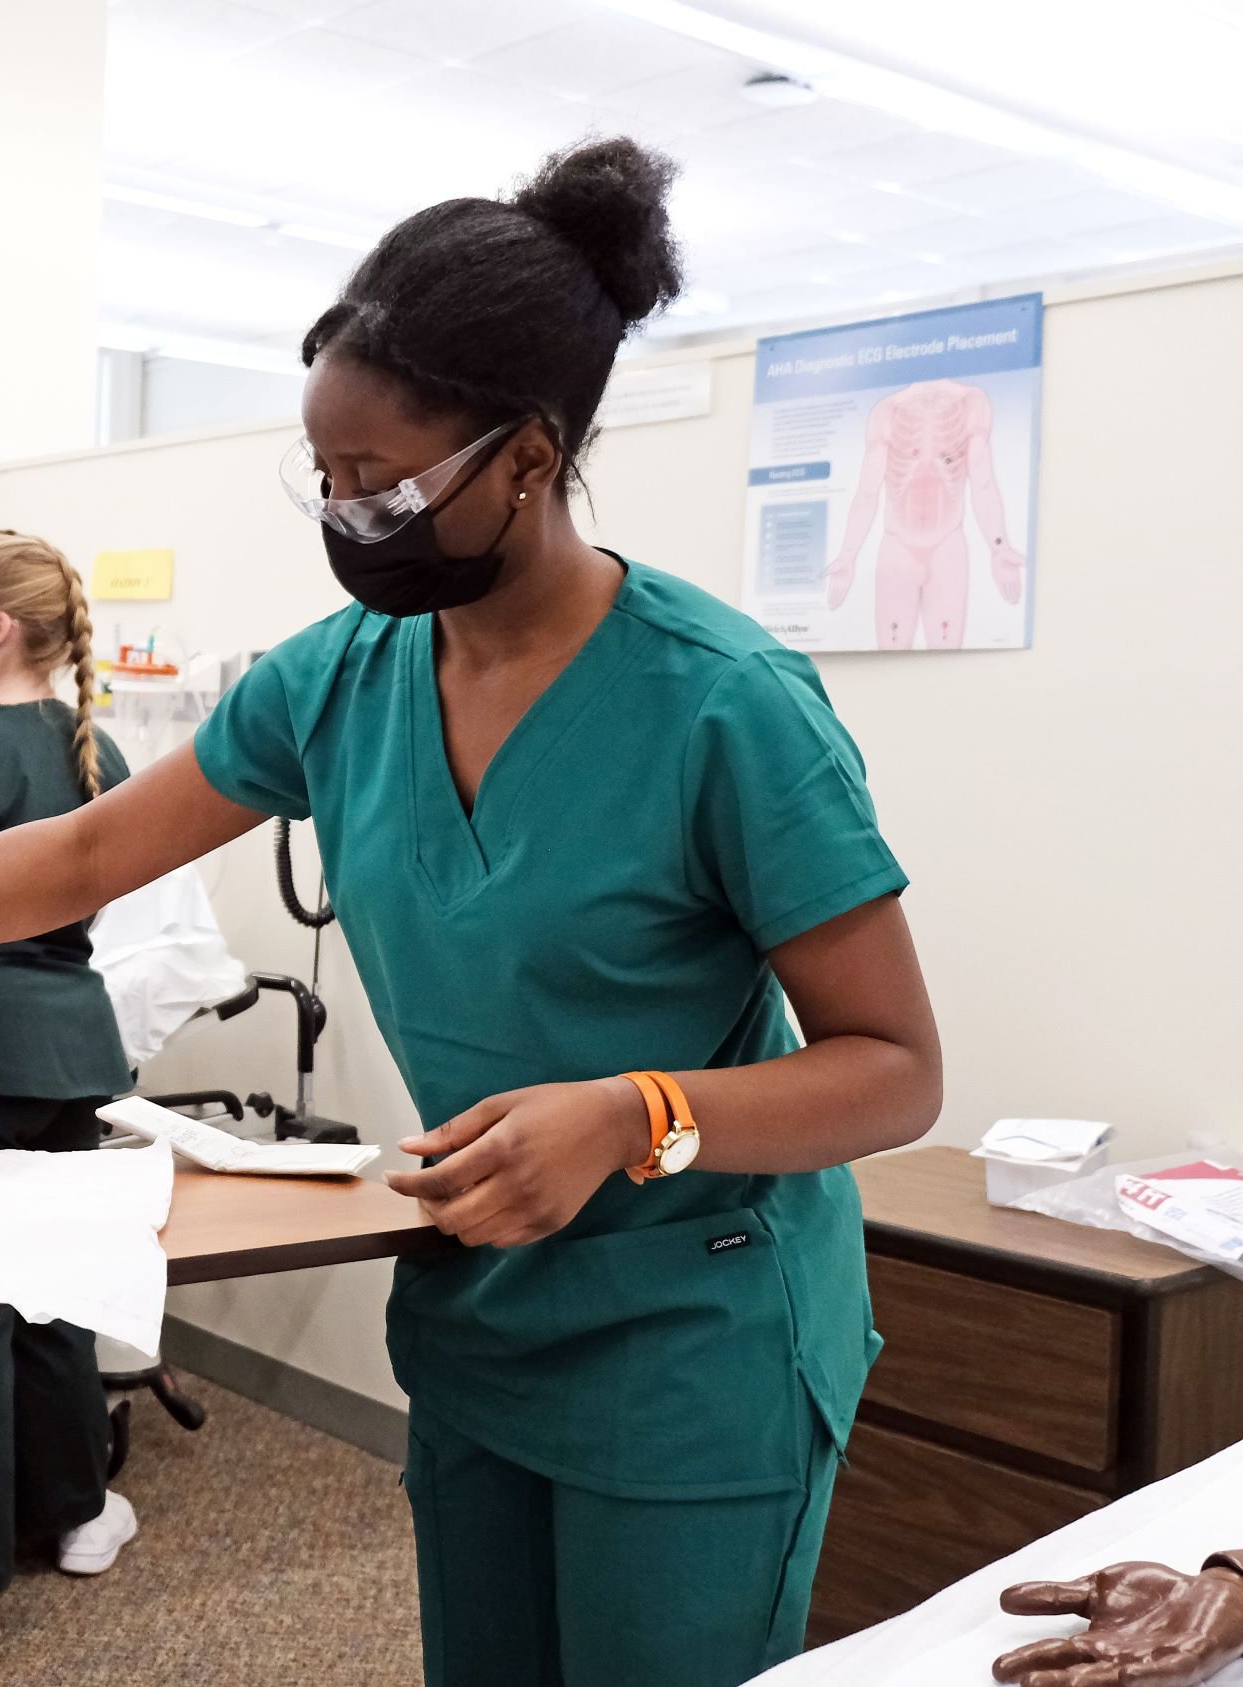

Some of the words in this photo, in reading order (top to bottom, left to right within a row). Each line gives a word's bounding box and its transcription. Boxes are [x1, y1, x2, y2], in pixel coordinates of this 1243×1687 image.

[766, 361, 792, 378] AHA
[794, 353, 855, 375] Diagnostic
[857, 347, 883, 365] ECG
[885, 338, 944, 361] Electrode
[947, 328, 1017, 352] Placement
[711, 1235, 747, 1250] JOCKEY
